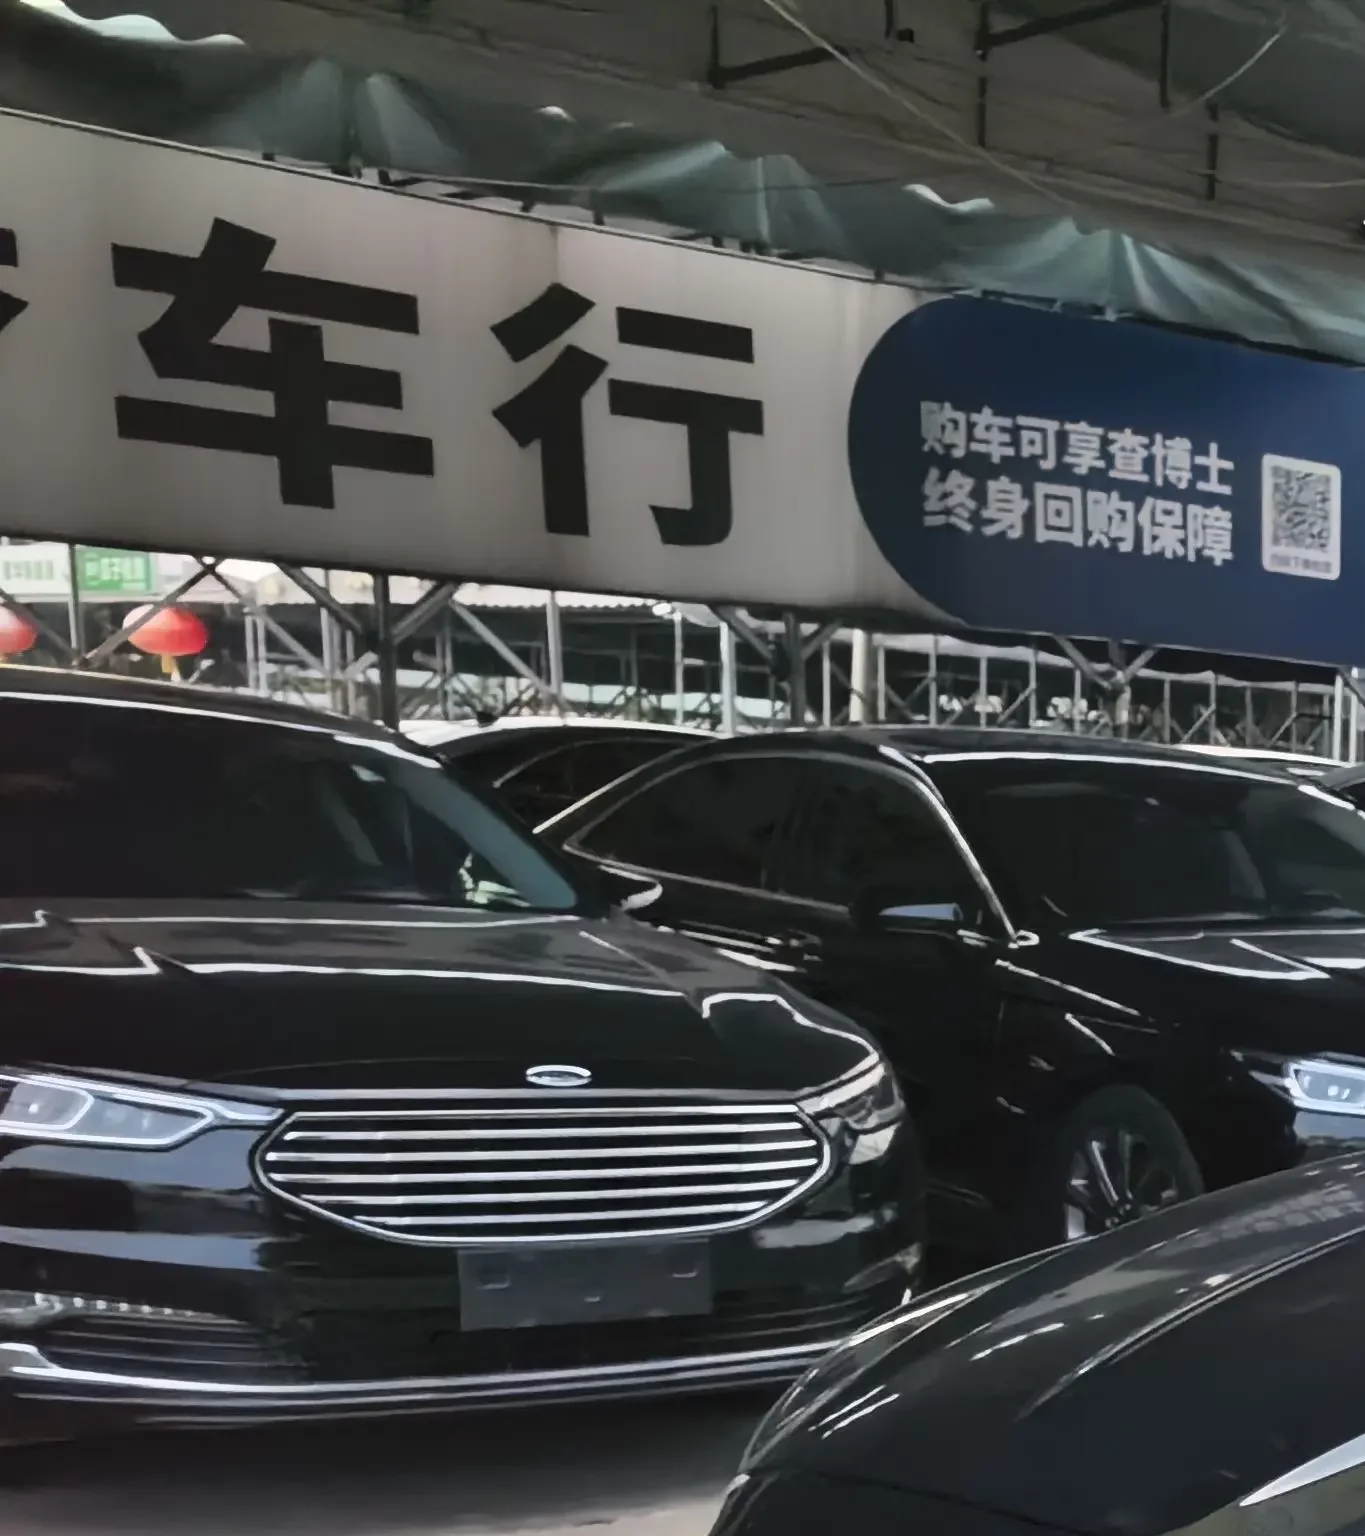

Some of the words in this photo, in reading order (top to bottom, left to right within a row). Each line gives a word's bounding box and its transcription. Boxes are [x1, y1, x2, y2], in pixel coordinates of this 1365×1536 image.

[0, 217, 764, 546] 车行
[920, 400, 1236, 496] 购车可享查博士
[922, 465, 1234, 567] 终身回购保障
